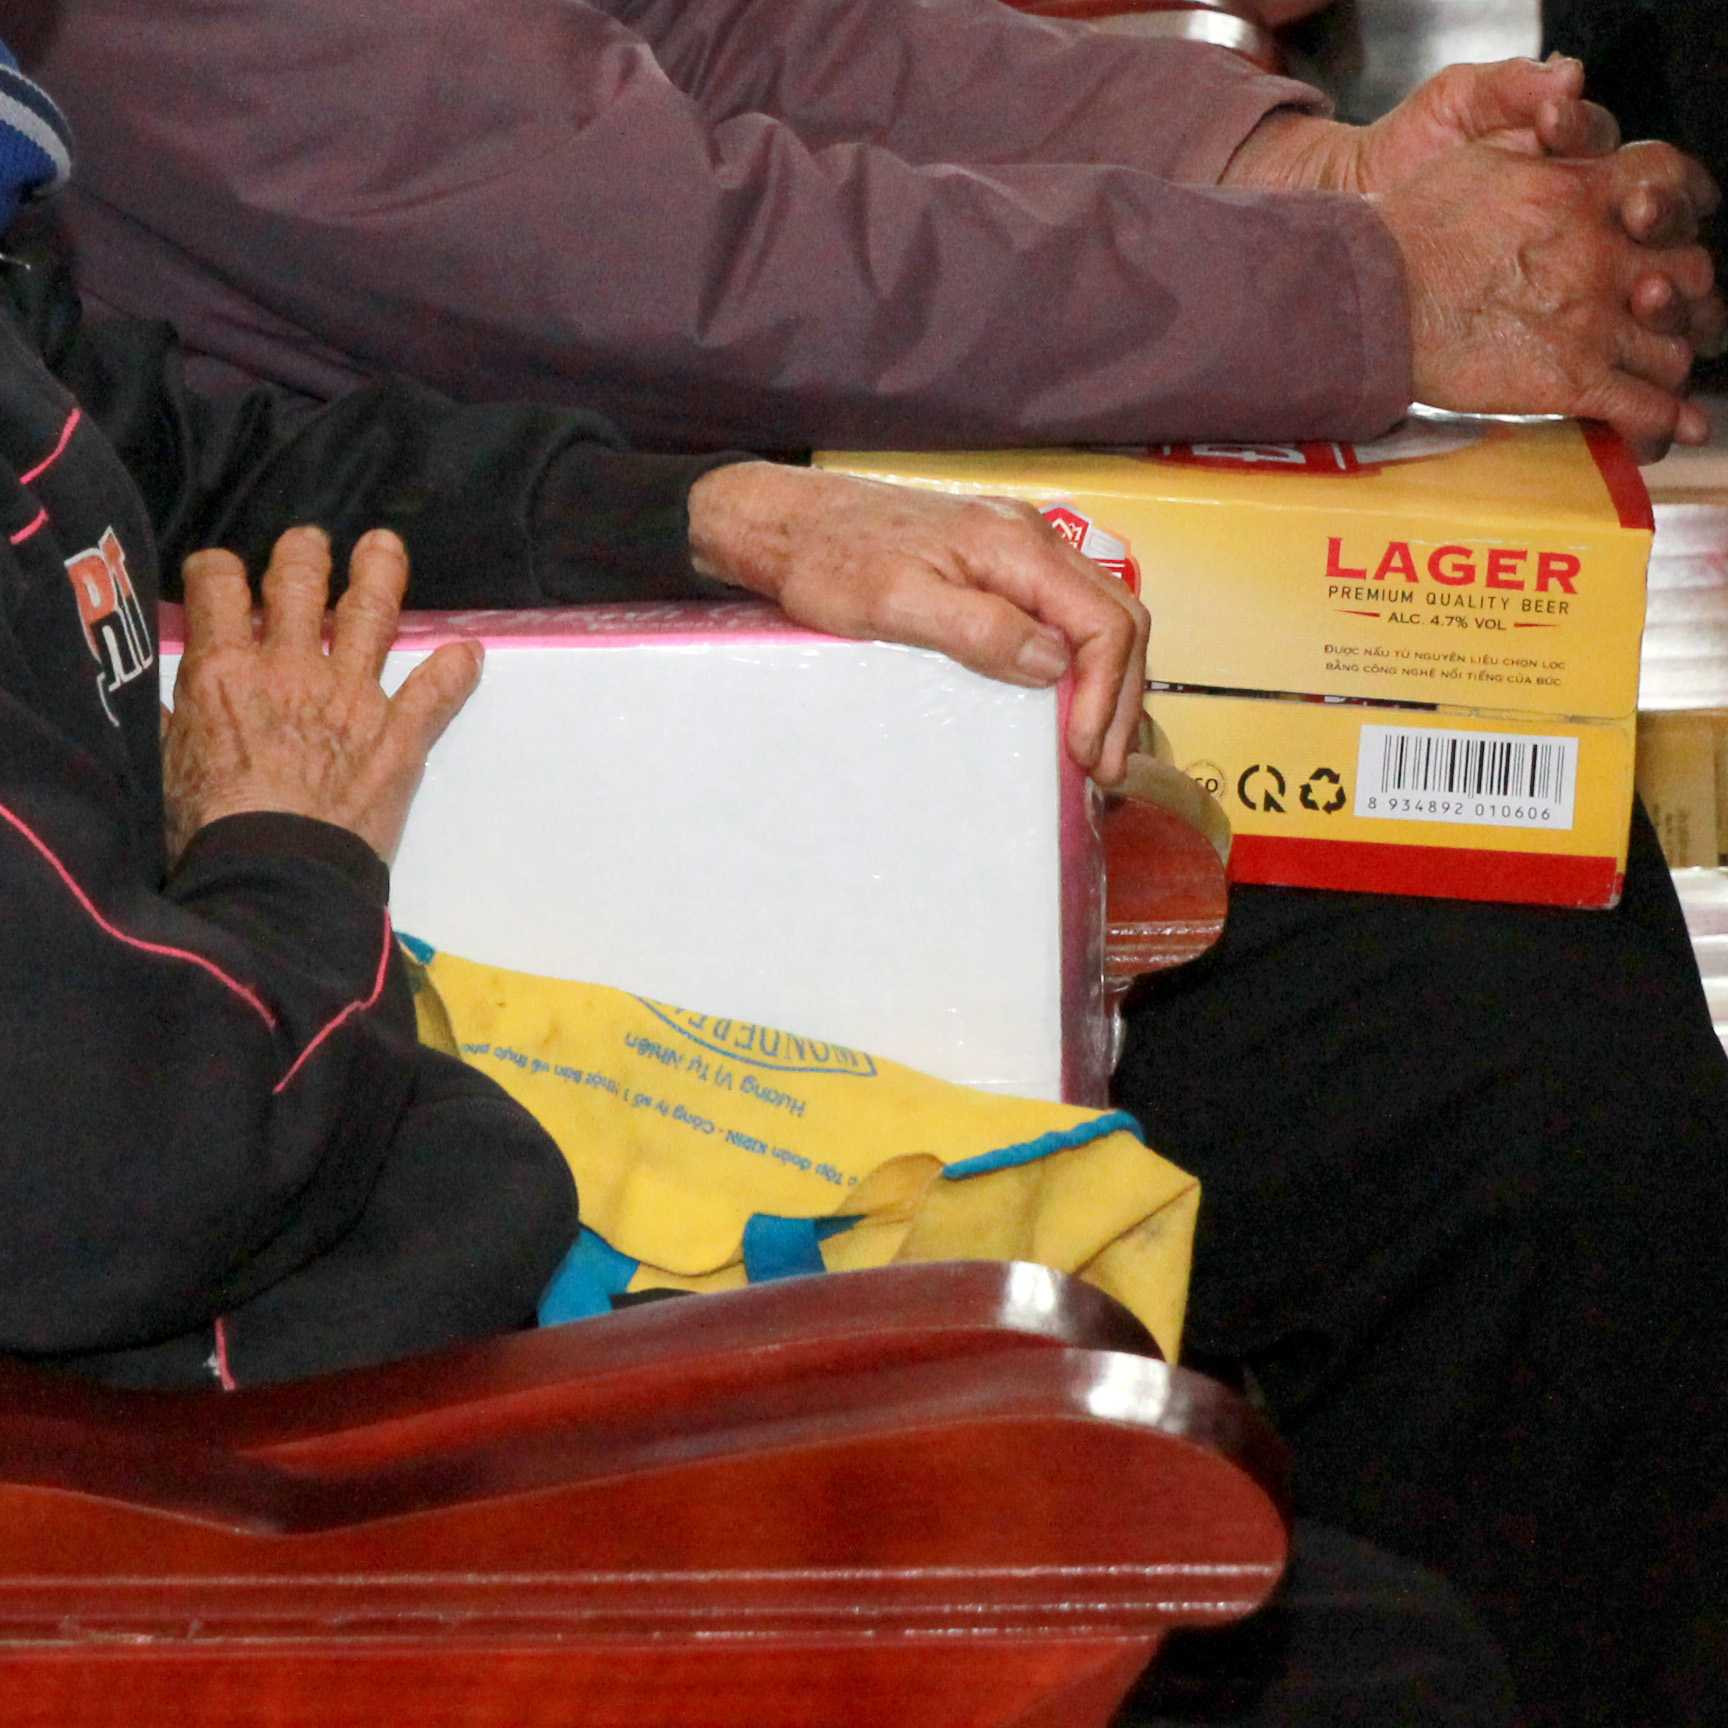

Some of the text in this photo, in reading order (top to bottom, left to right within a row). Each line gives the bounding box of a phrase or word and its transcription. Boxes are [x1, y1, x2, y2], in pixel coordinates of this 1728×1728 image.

[1325, 536, 1582, 594] LAGER
[1328, 585, 1570, 615] PREMIUM QUALITY BEER
[1387, 611, 1507, 631] ALC. 4.7% VOL
[1366, 795, 1552, 822] 8 934892 010606
